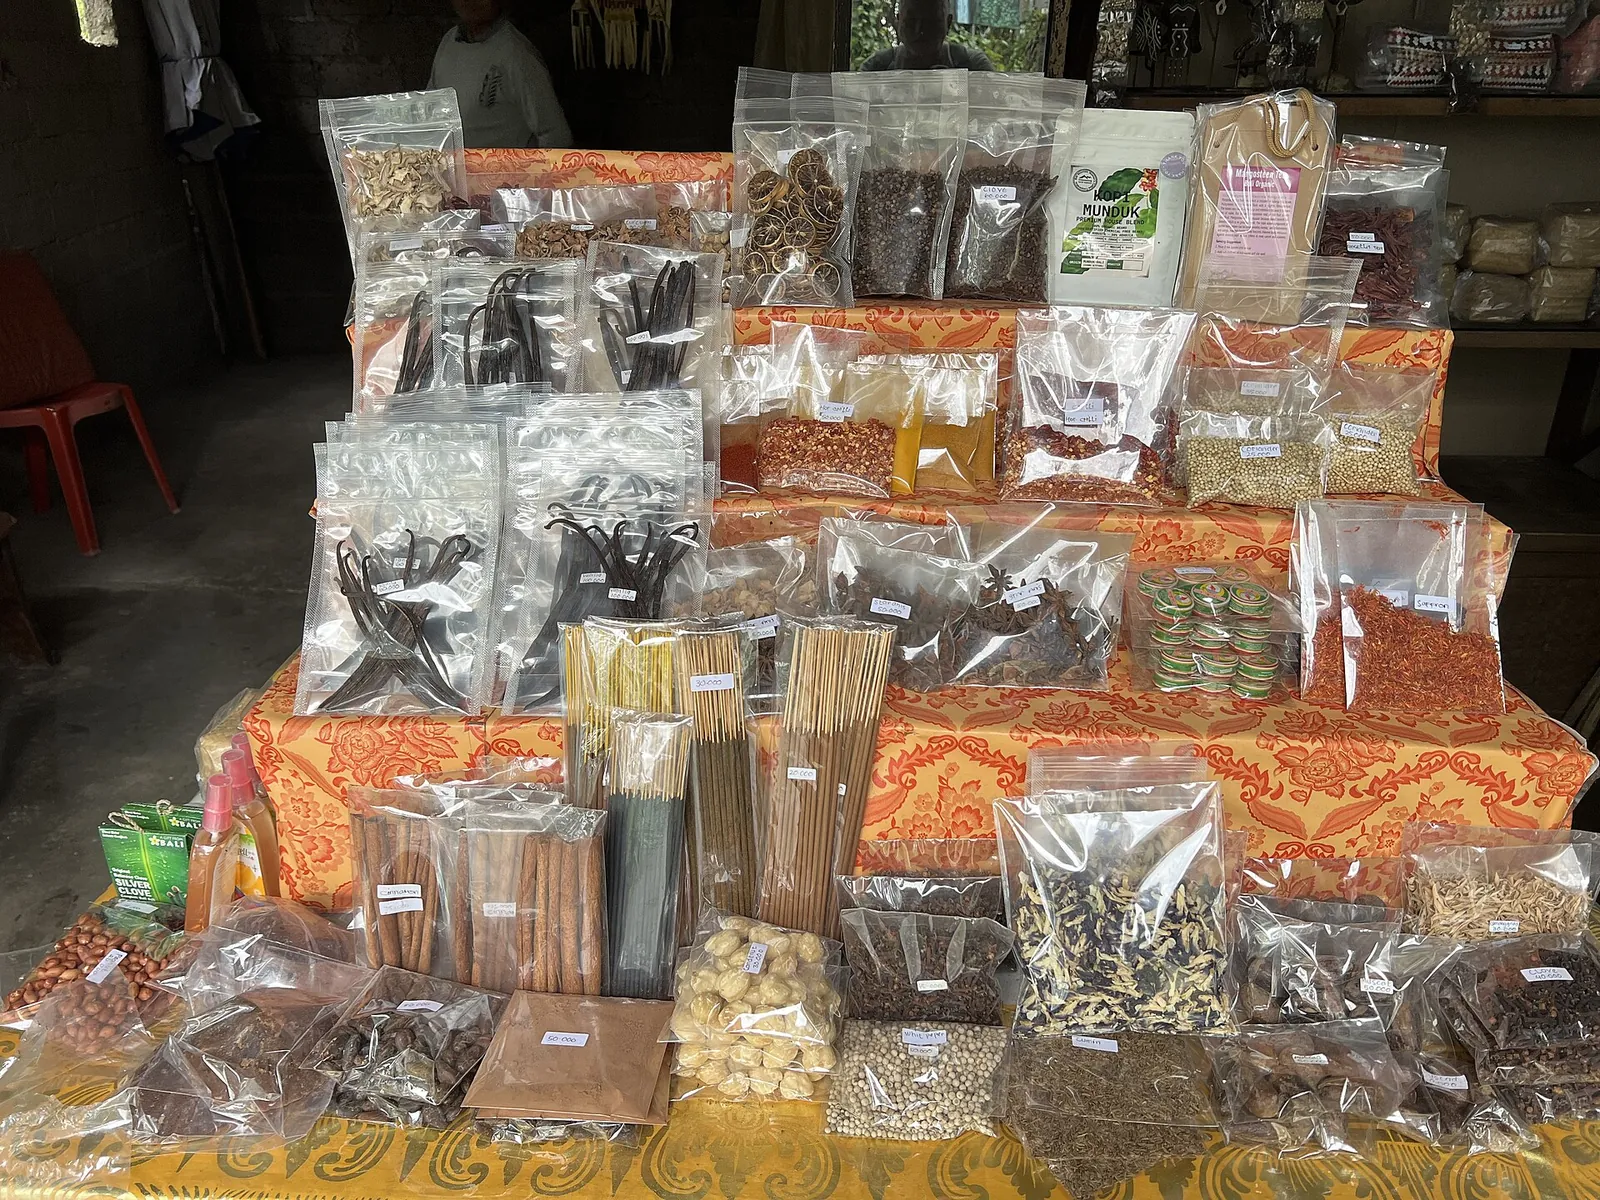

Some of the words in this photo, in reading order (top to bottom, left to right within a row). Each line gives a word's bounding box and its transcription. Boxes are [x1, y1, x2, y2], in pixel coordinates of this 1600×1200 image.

[1094, 189, 1130, 203] KOPI
[1083, 203, 1140, 218] MUNDUK
[159, 840, 184, 848] BALI
[115, 879, 152, 890] SILVER
[118, 887, 152, 898] CLOVE
[548, 1035, 577, 1043] 50.000
